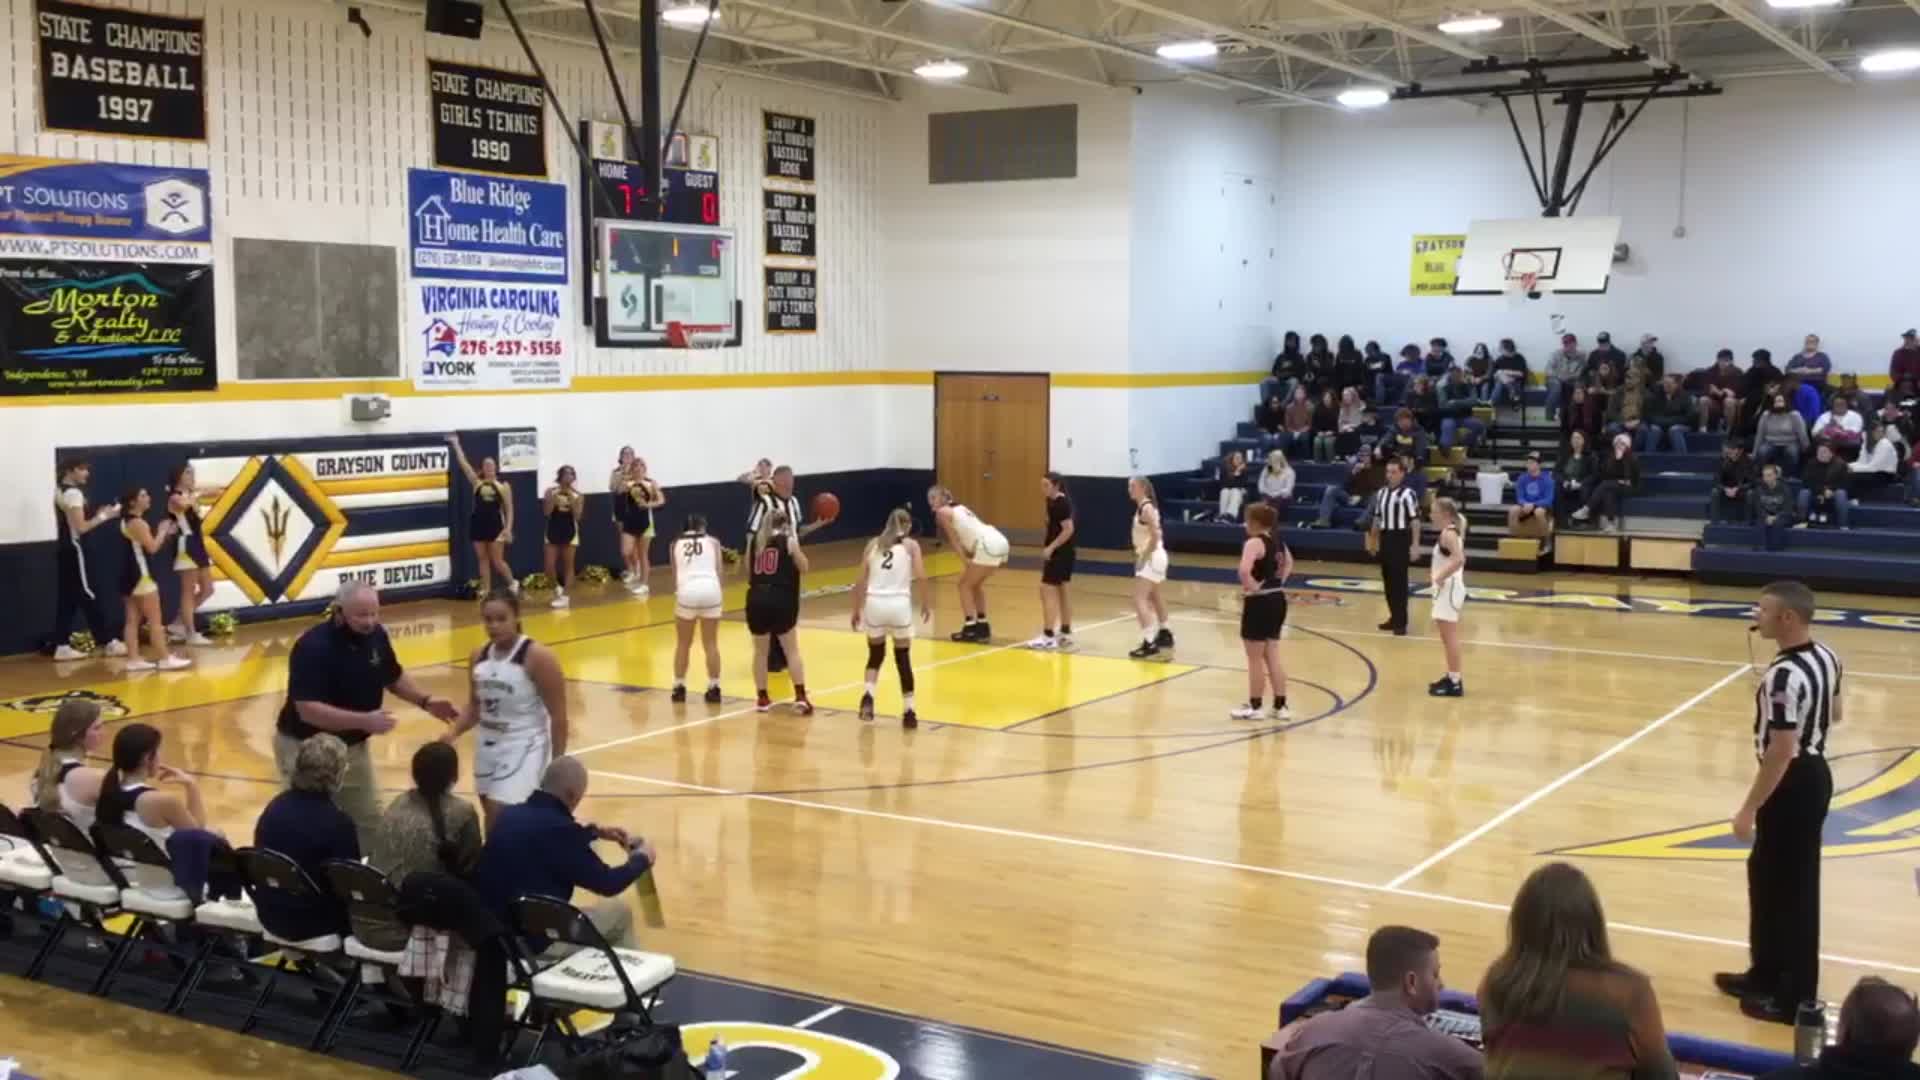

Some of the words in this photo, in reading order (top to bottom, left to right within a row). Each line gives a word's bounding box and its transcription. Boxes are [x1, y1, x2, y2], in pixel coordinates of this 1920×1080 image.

[39, 12, 92, 45] STATE
[105, 23, 201, 56] CHAMPIONS
[51, 52, 195, 90] BASEBALL
[432, 72, 470, 96] STATE
[475, 77, 543, 107] CHAMPIONS
[97, 95, 152, 123] 1997
[441, 103, 482, 129] GIRLS
[486, 109, 537, 135] TENNIS
[471, 138, 511, 162] 1990
[599, 163, 629, 179] HOME
[685, 172, 715, 188] GUEST
[24, 187, 128, 211] SOLUTIONS
[450, 177, 485, 205] Blue
[488, 181, 532, 215] Ridge
[702, 191, 717, 224] 0
[423, 214, 479, 243] Home
[480, 218, 527, 245] Health
[529, 223, 564, 249] Care
[22, 286, 160, 315] Morton
[421, 286, 487, 314] VIRGINIA
[489, 287, 560, 318] CAROLINA
[51, 306, 149, 337] Realty
[54, 330, 70, 343] &
[142, 328, 183, 344] LLC
[436, 360, 476, 376] YORK
[316, 455, 384, 477] GRAYSON
[391, 451, 449, 471] COUNTY
[682, 541, 703, 557] 20
[754, 546, 780, 575] 10
[881, 550, 894, 570] 2
[338, 569, 377, 587] BLUE
[383, 563, 434, 585] DEVILS
